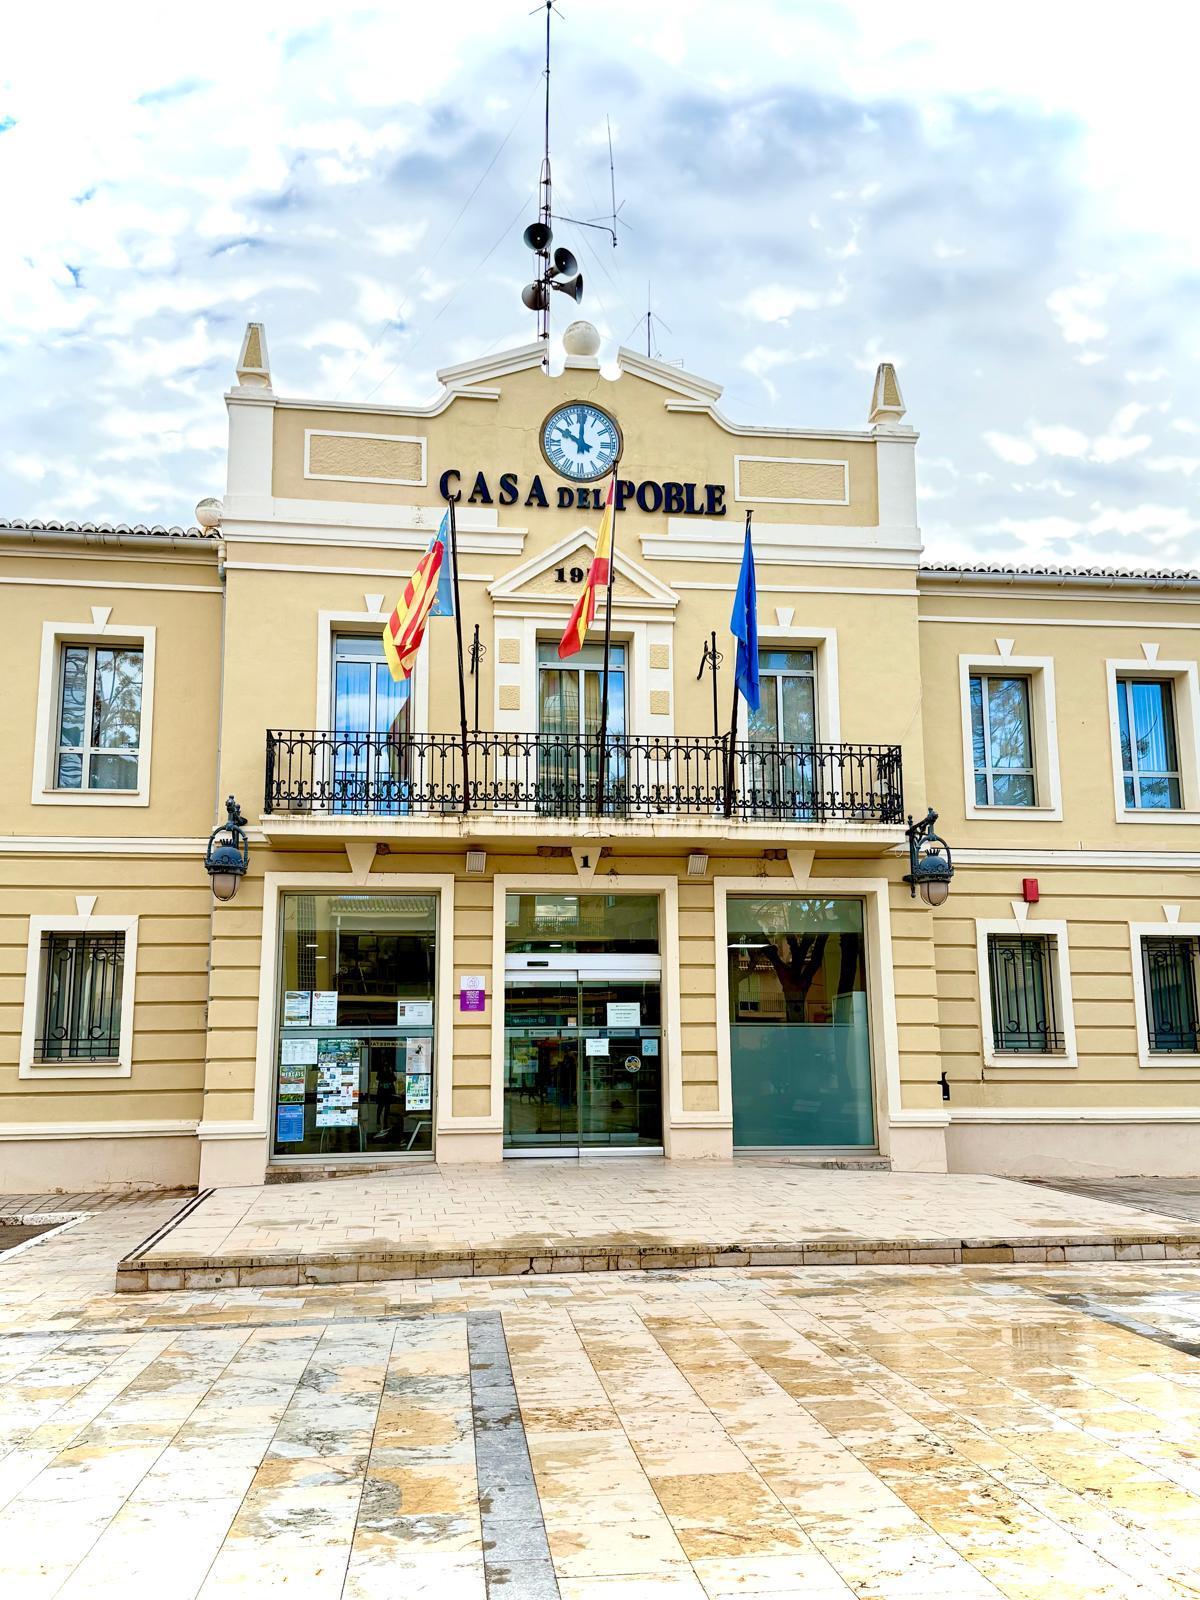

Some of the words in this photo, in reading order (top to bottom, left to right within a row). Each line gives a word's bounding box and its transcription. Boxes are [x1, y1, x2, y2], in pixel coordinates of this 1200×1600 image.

[439, 469, 549, 508] CASA
[557, 486, 606, 509] DEL
[615, 479, 727, 516] POBLE
[555, 567, 616, 583] 19
[580, 855, 591, 868] 1
